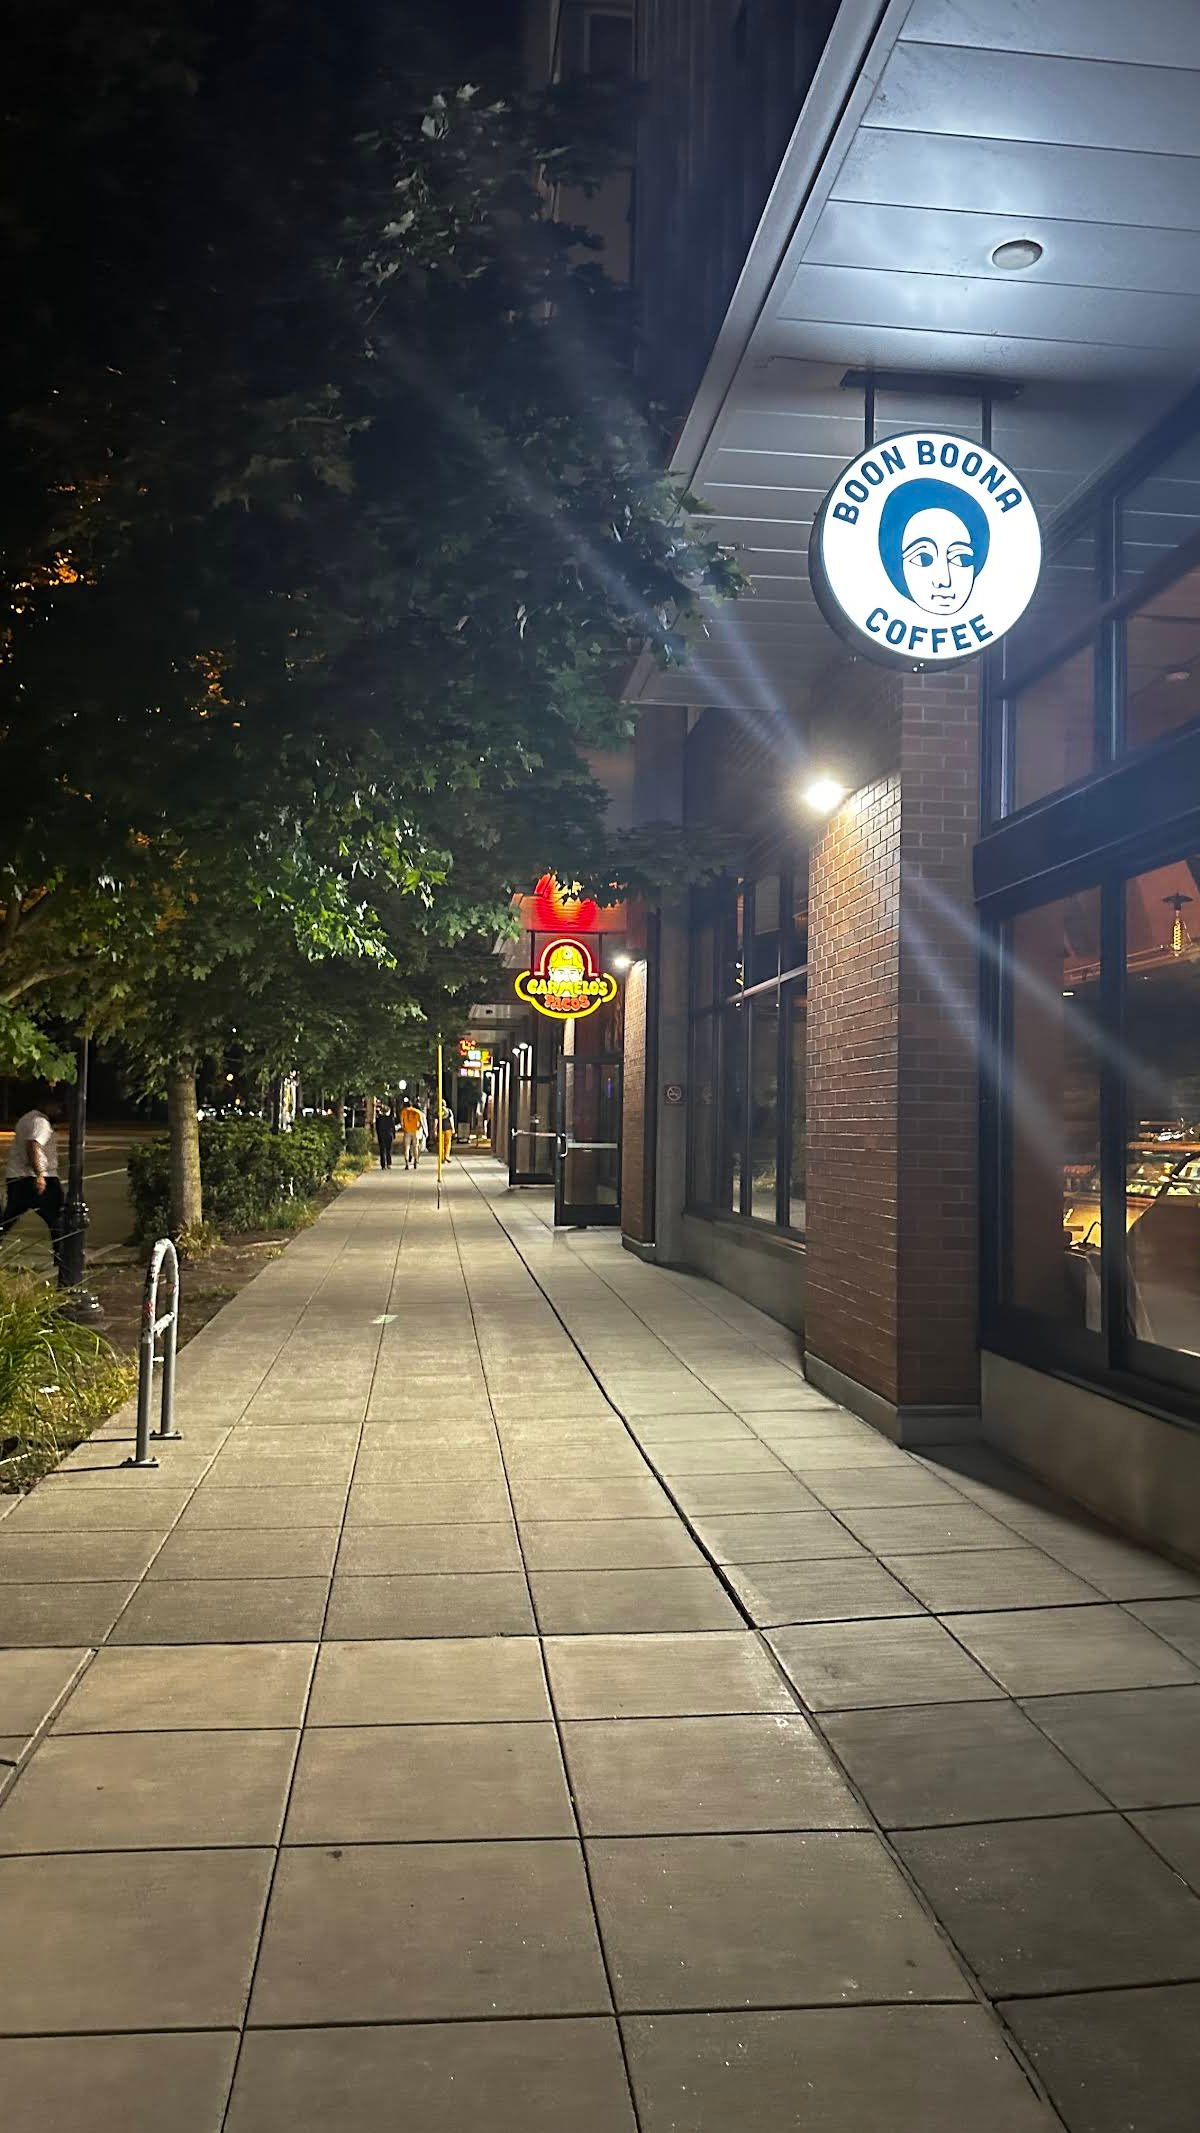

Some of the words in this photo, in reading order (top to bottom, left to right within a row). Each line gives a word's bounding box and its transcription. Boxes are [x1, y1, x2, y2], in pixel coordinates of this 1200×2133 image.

[833, 445, 906, 525] BOON
[917, 440, 1023, 513] BOONA
[865, 607, 994, 653] COFFEE
[526, 978, 609, 996] CARMELO'S
[544, 994, 591, 1011] TACOS
